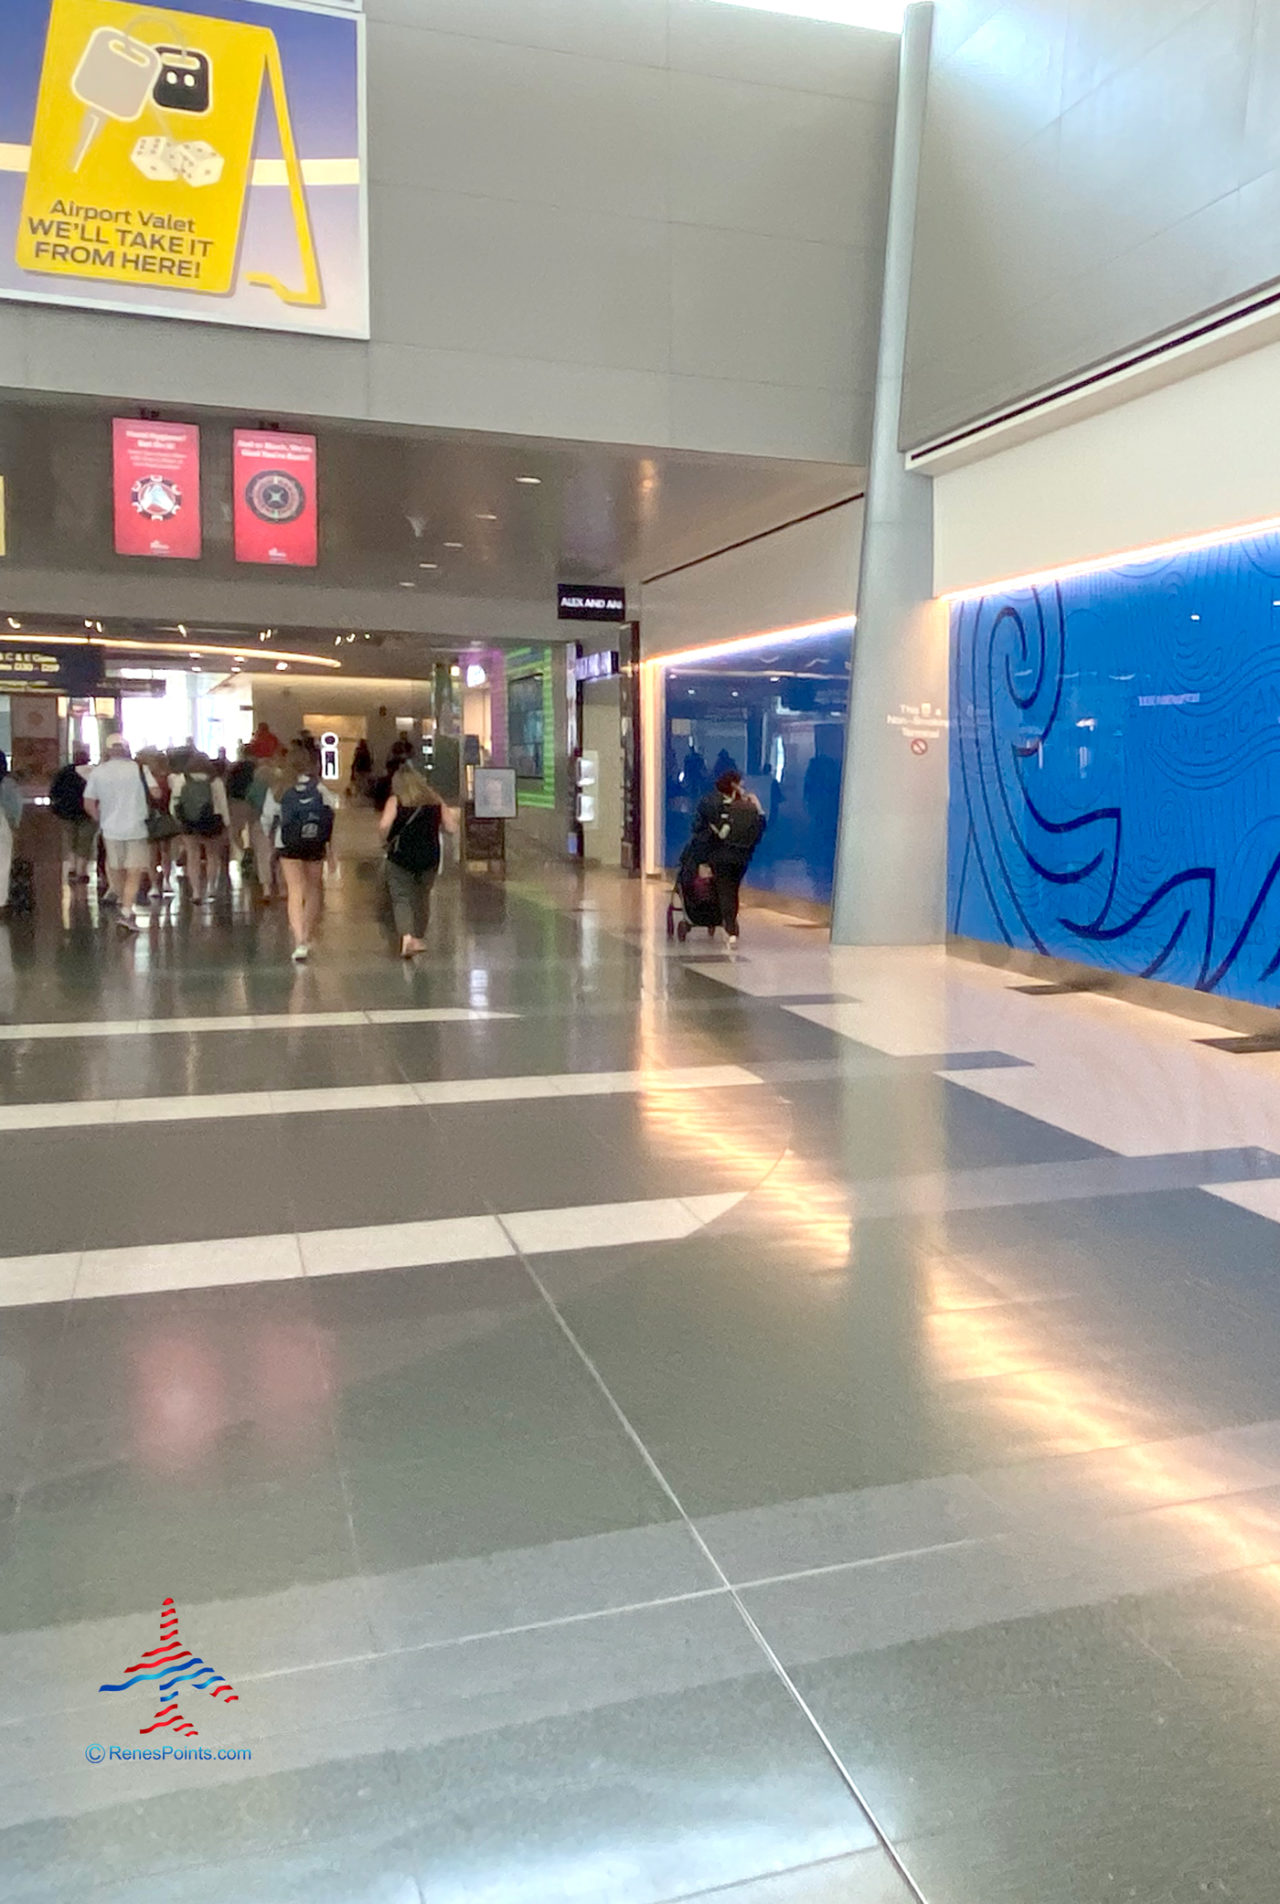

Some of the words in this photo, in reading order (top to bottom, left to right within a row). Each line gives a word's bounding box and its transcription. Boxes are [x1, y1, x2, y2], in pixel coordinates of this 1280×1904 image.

[50, 199, 131, 225] Airport
[137, 211, 196, 234] Valet
[28, 217, 110, 245] WE'LL
[115, 228, 185, 255] TAKE
[189, 239, 214, 258] IT
[34, 241, 115, 269] FROM
[121, 251, 201, 279] HERE!
